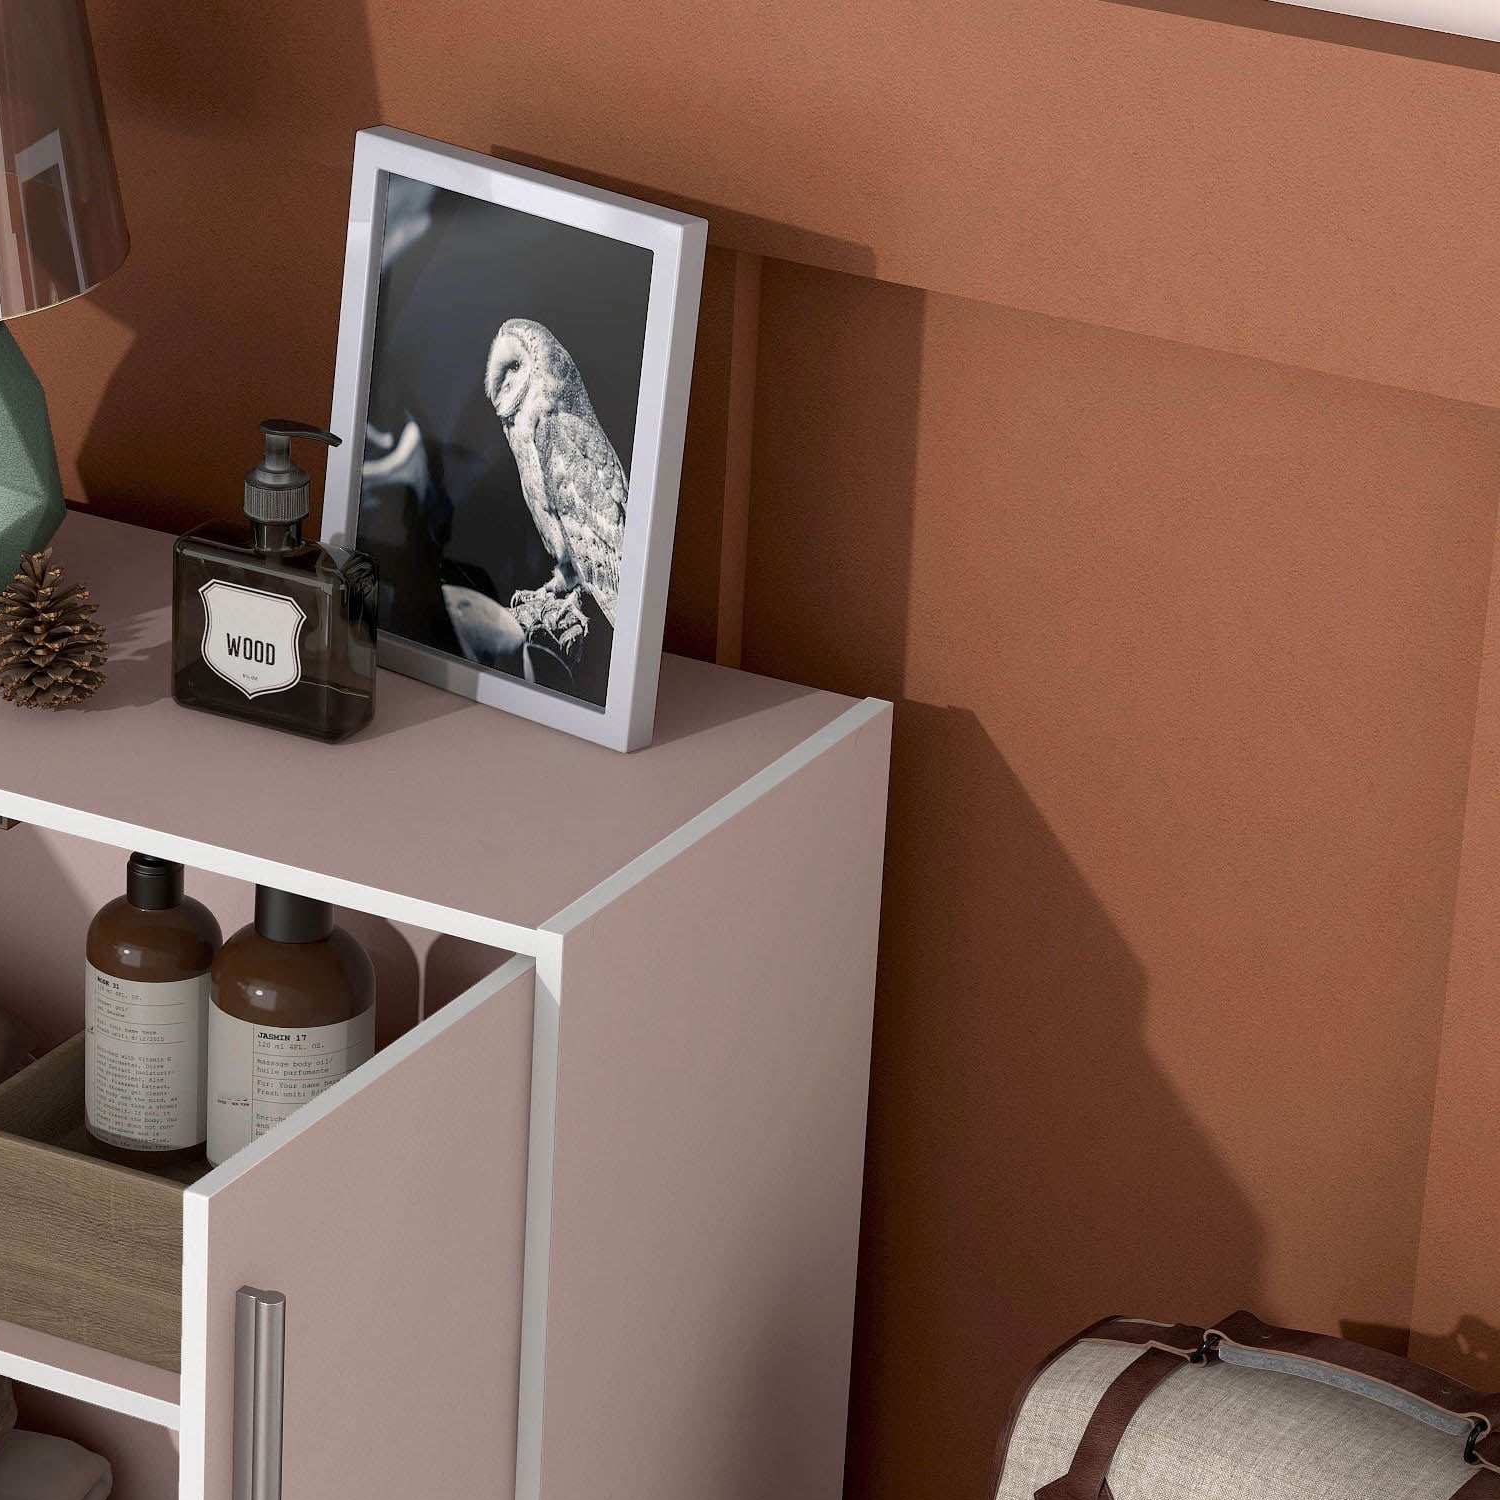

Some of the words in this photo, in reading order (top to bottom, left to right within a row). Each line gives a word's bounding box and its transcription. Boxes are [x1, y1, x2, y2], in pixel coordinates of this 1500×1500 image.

[226, 632, 276, 666] WOOD
[257, 1032, 291, 1041] JASMIN
[295, 1034, 307, 1042] 17
[257, 1041, 271, 1049] 120
[256, 1058, 289, 1068] massage
[292, 1060, 313, 1068] body
[256, 1067, 280, 1075] huile
[257, 1079, 274, 1088] For:
[278, 1081, 298, 1089] Your
[256, 1088, 279, 1097] Fresh
